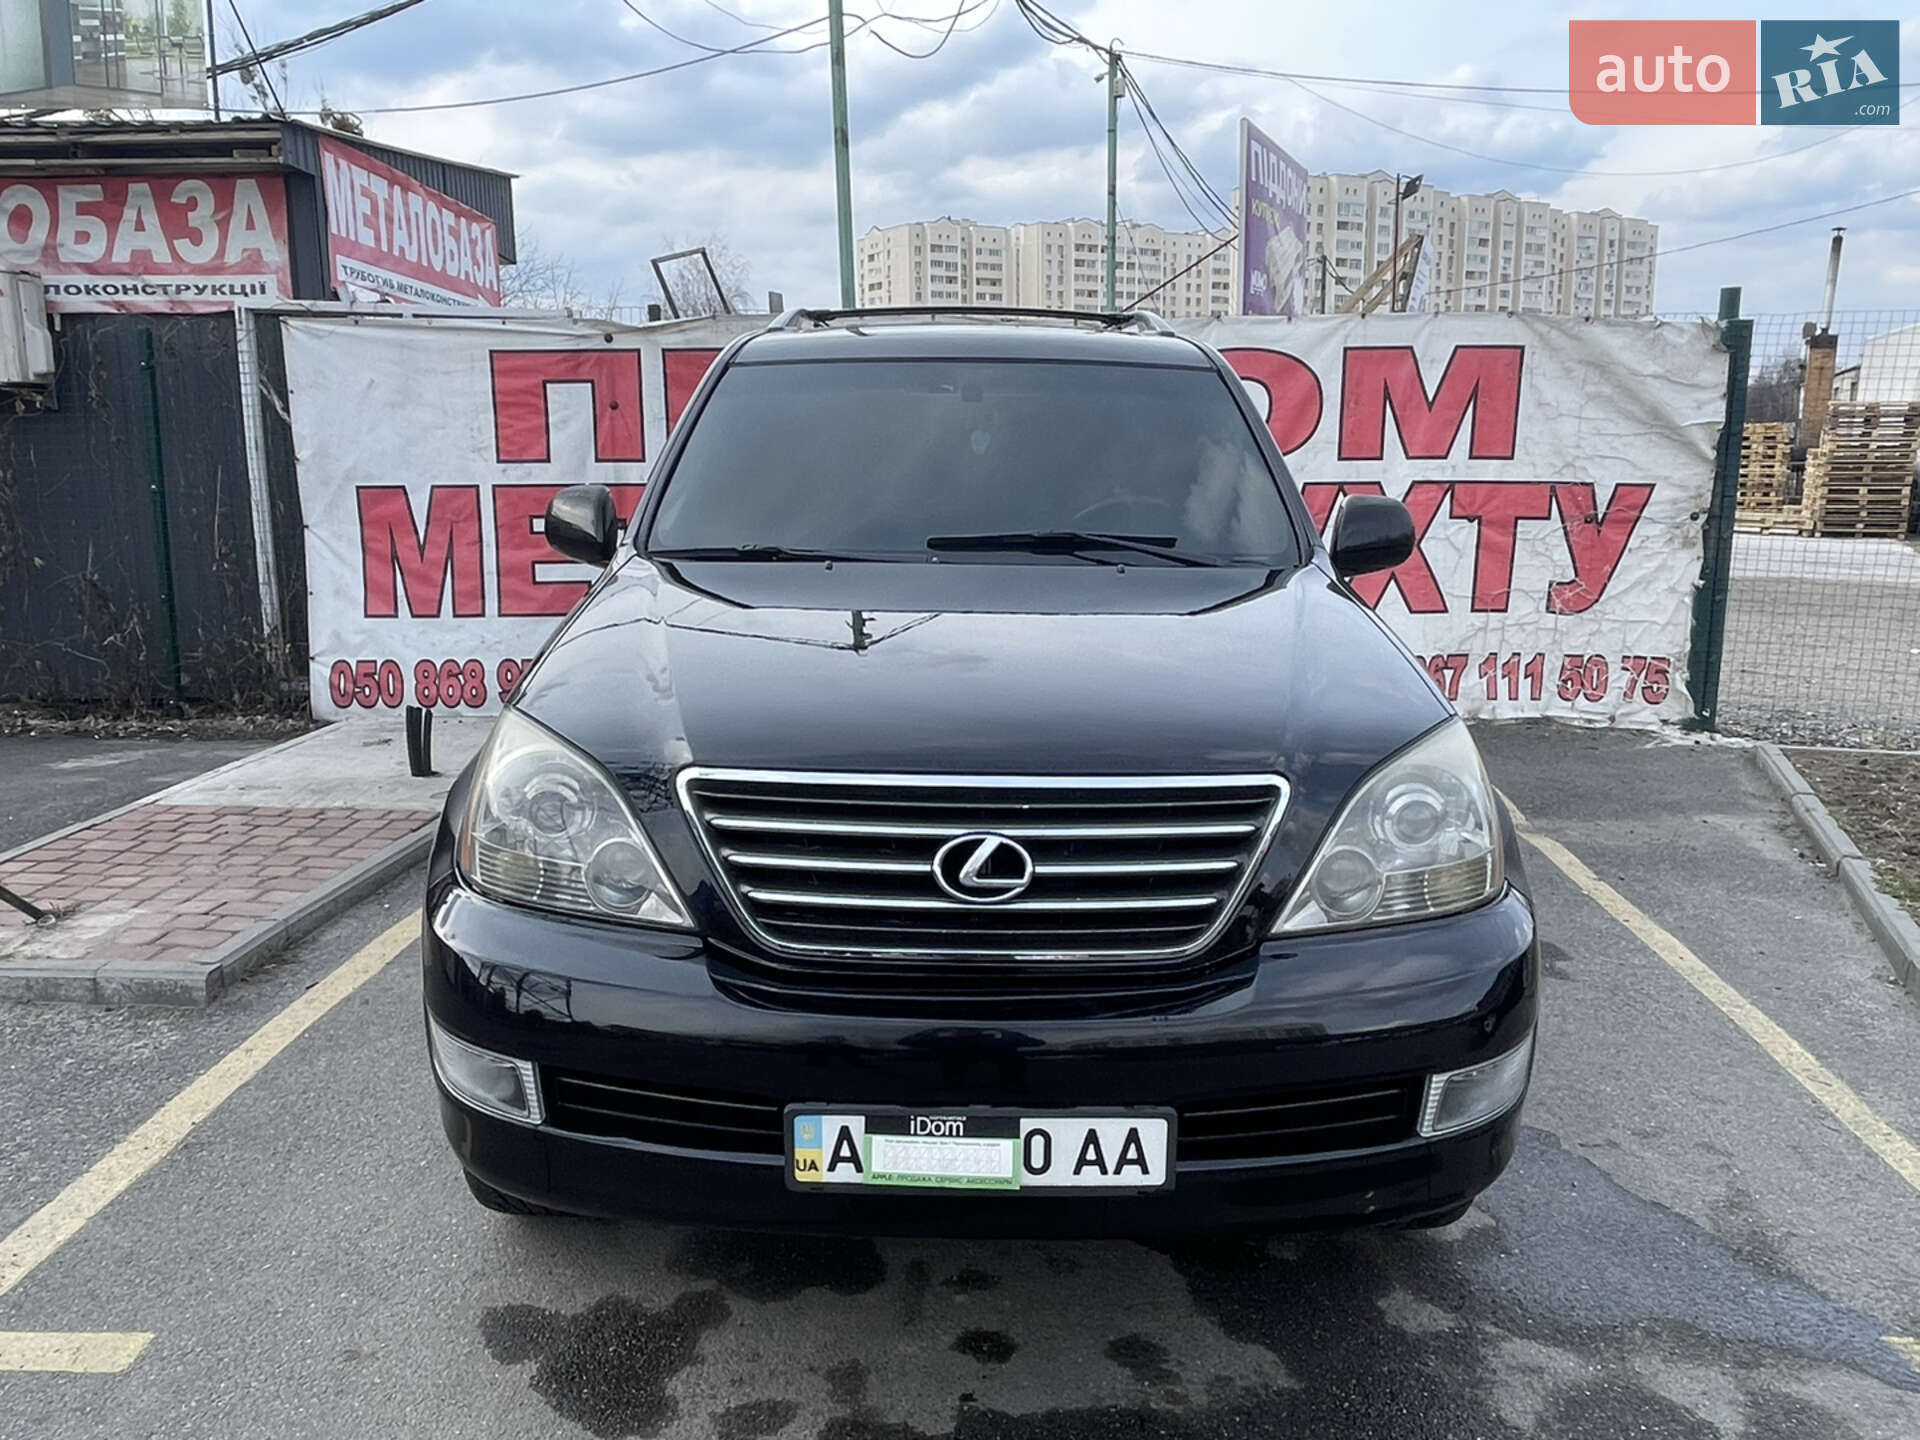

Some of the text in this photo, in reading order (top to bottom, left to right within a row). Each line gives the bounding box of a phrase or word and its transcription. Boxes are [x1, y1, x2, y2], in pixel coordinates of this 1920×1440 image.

[0, 178, 281, 265] ОБАЗА
[324, 151, 498, 292] МЕТАЛОБАЗА
[329, 658, 404, 708] 050
[413, 658, 487, 708] 868
[1478, 652, 1545, 701] 111
[1557, 654, 1609, 704] 50
[1621, 655, 1671, 704] 75
[795, 1157, 820, 1172] UA
[1073, 1127, 1150, 1176] AA
[909, 1116, 964, 1136] iDom
